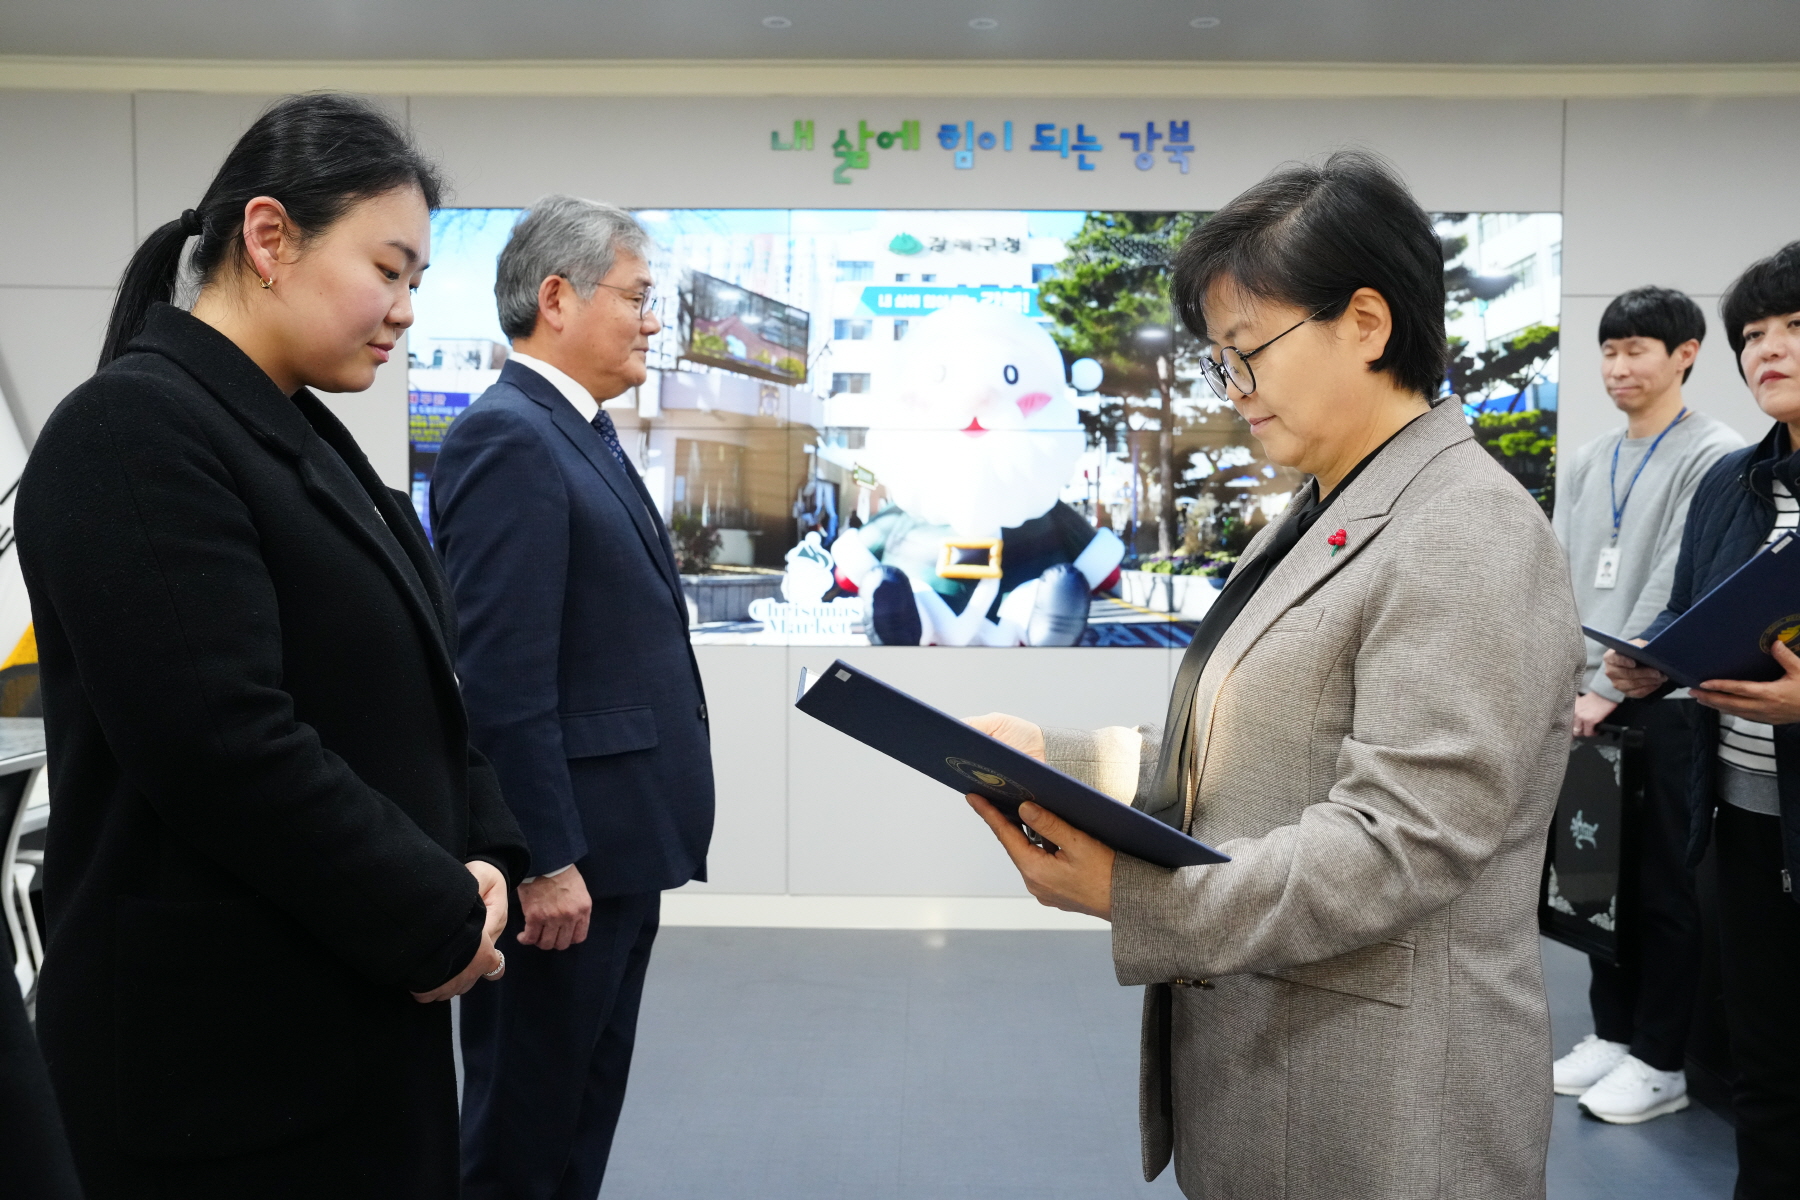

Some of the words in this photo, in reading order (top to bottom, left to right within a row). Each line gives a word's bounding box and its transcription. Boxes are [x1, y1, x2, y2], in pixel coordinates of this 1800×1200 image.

[771, 120, 815, 150] 내
[832, 120, 921, 184] 삶에
[937, 120, 1014, 170] 힘이
[1030, 123, 1103, 171] 되는
[1119, 121, 1195, 174] 강북
[752, 602, 861, 617] Christmas
[768, 618, 847, 634] Market
